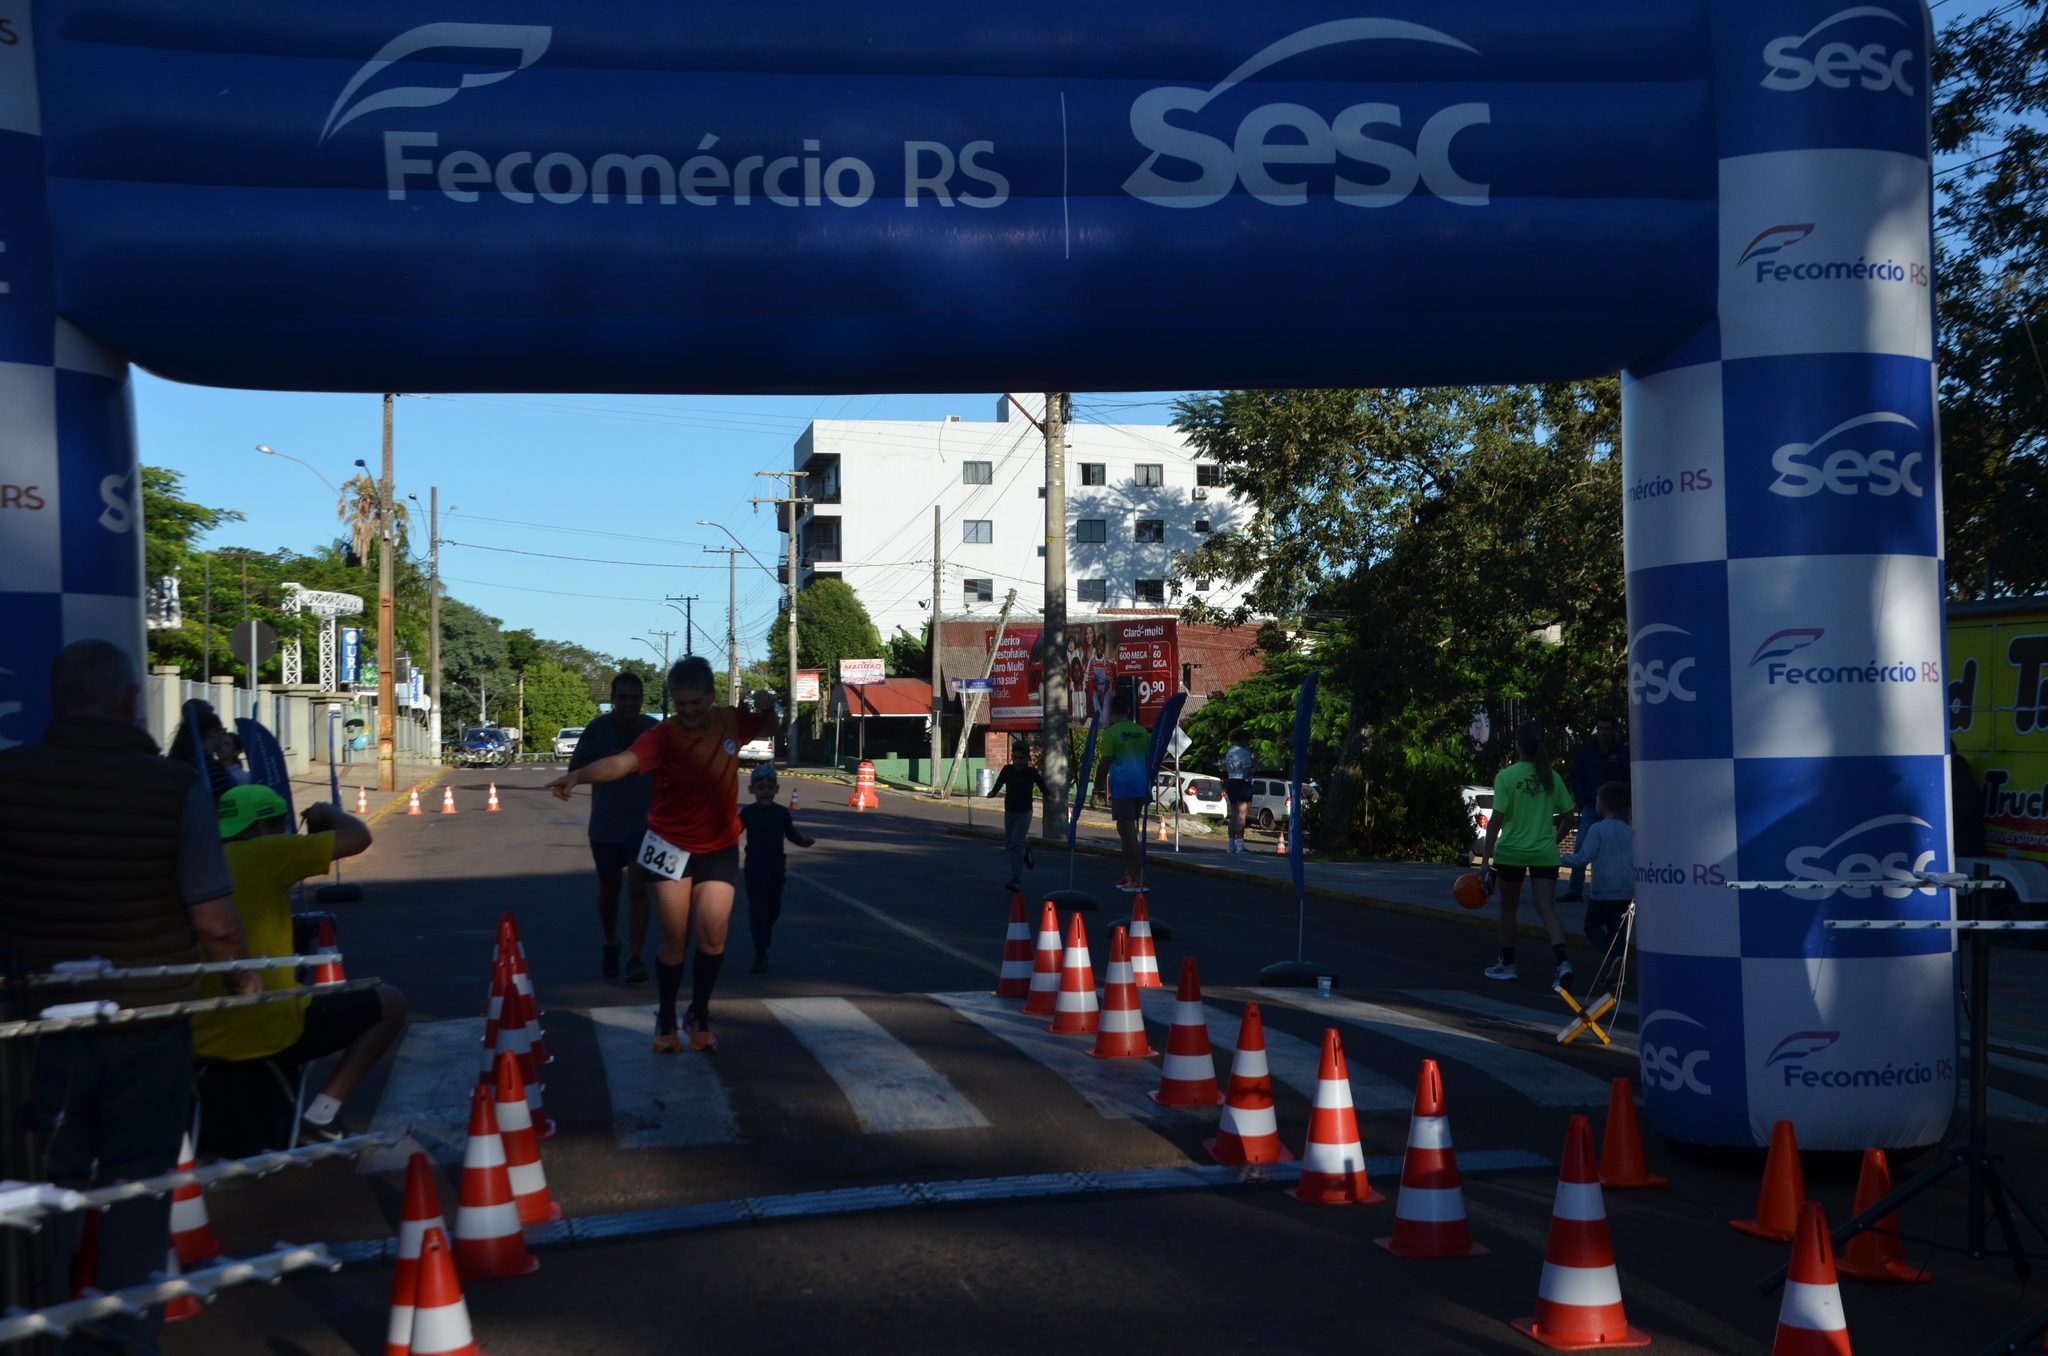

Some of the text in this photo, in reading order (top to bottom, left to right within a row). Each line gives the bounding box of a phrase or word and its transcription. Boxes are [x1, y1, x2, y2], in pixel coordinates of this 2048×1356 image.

[384, 131, 1010, 209] Fecomércio RS
[1757, 257, 1928, 287] Fecomércio RS
[0, 484, 45, 511] RS
[1627, 468, 1713, 503] mércio RS
[990, 662, 1006, 672] laro
[993, 649, 1030, 661] estphalen,
[1119, 650, 1148, 660] 600 MEGA
[1152, 659, 1168, 668] GIGA
[1153, 650, 1162, 659] 60
[1631, 657, 1697, 705] esc
[1768, 660, 1940, 685] Fecomércio RS
[643, 845, 679, 875] 843
[1693, 864, 1725, 887] RS
[1639, 1042, 1713, 1096] esc
[1784, 1059, 1953, 1088] Fecomércio RS
